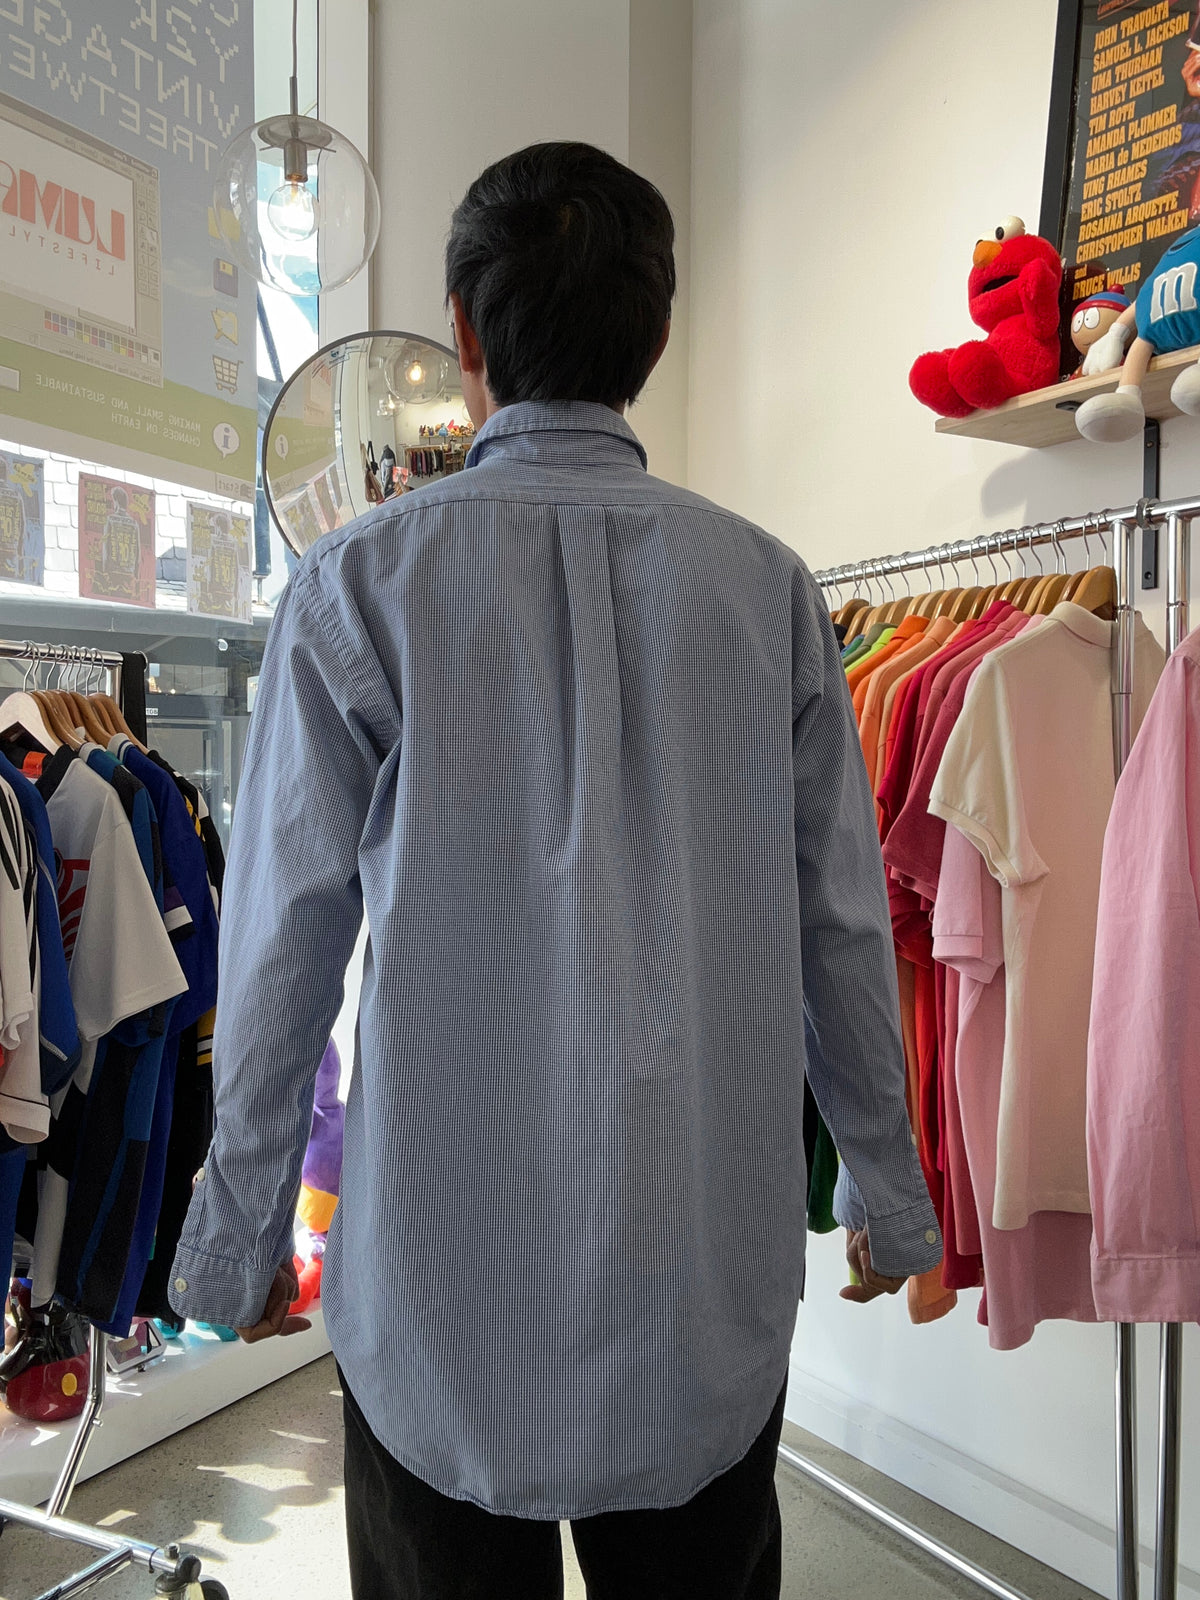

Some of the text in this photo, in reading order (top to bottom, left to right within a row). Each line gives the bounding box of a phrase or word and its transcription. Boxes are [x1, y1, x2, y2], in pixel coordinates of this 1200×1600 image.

[1093, 23, 1118, 52] JOHN
[1120, 0, 1169, 39] TRAVOLTA
[1093, 11, 1190, 73] SAMUEL L. JACKSON
[1090, 67, 1165, 116] HARVEY KEITEL
[1091, 45, 1163, 94] UMA THURMAN
[1086, 103, 1178, 158] AMANDA PLUMMER
[1089, 101, 1136, 137] TIM ROTH
[1085, 123, 1183, 180] MARIA de MEDEIROS
[1080, 181, 1142, 223] ERIC STOLTZ
[1083, 159, 1148, 200] VING RHAMES
[1076, 208, 1189, 264] CHRISTOPHER WALKEN
[1078, 190, 1179, 243] ROSANNA ARQUETTE
[1072, 261, 1142, 301] BRUCE WILLIS
[1074, 264, 1087, 279] and
